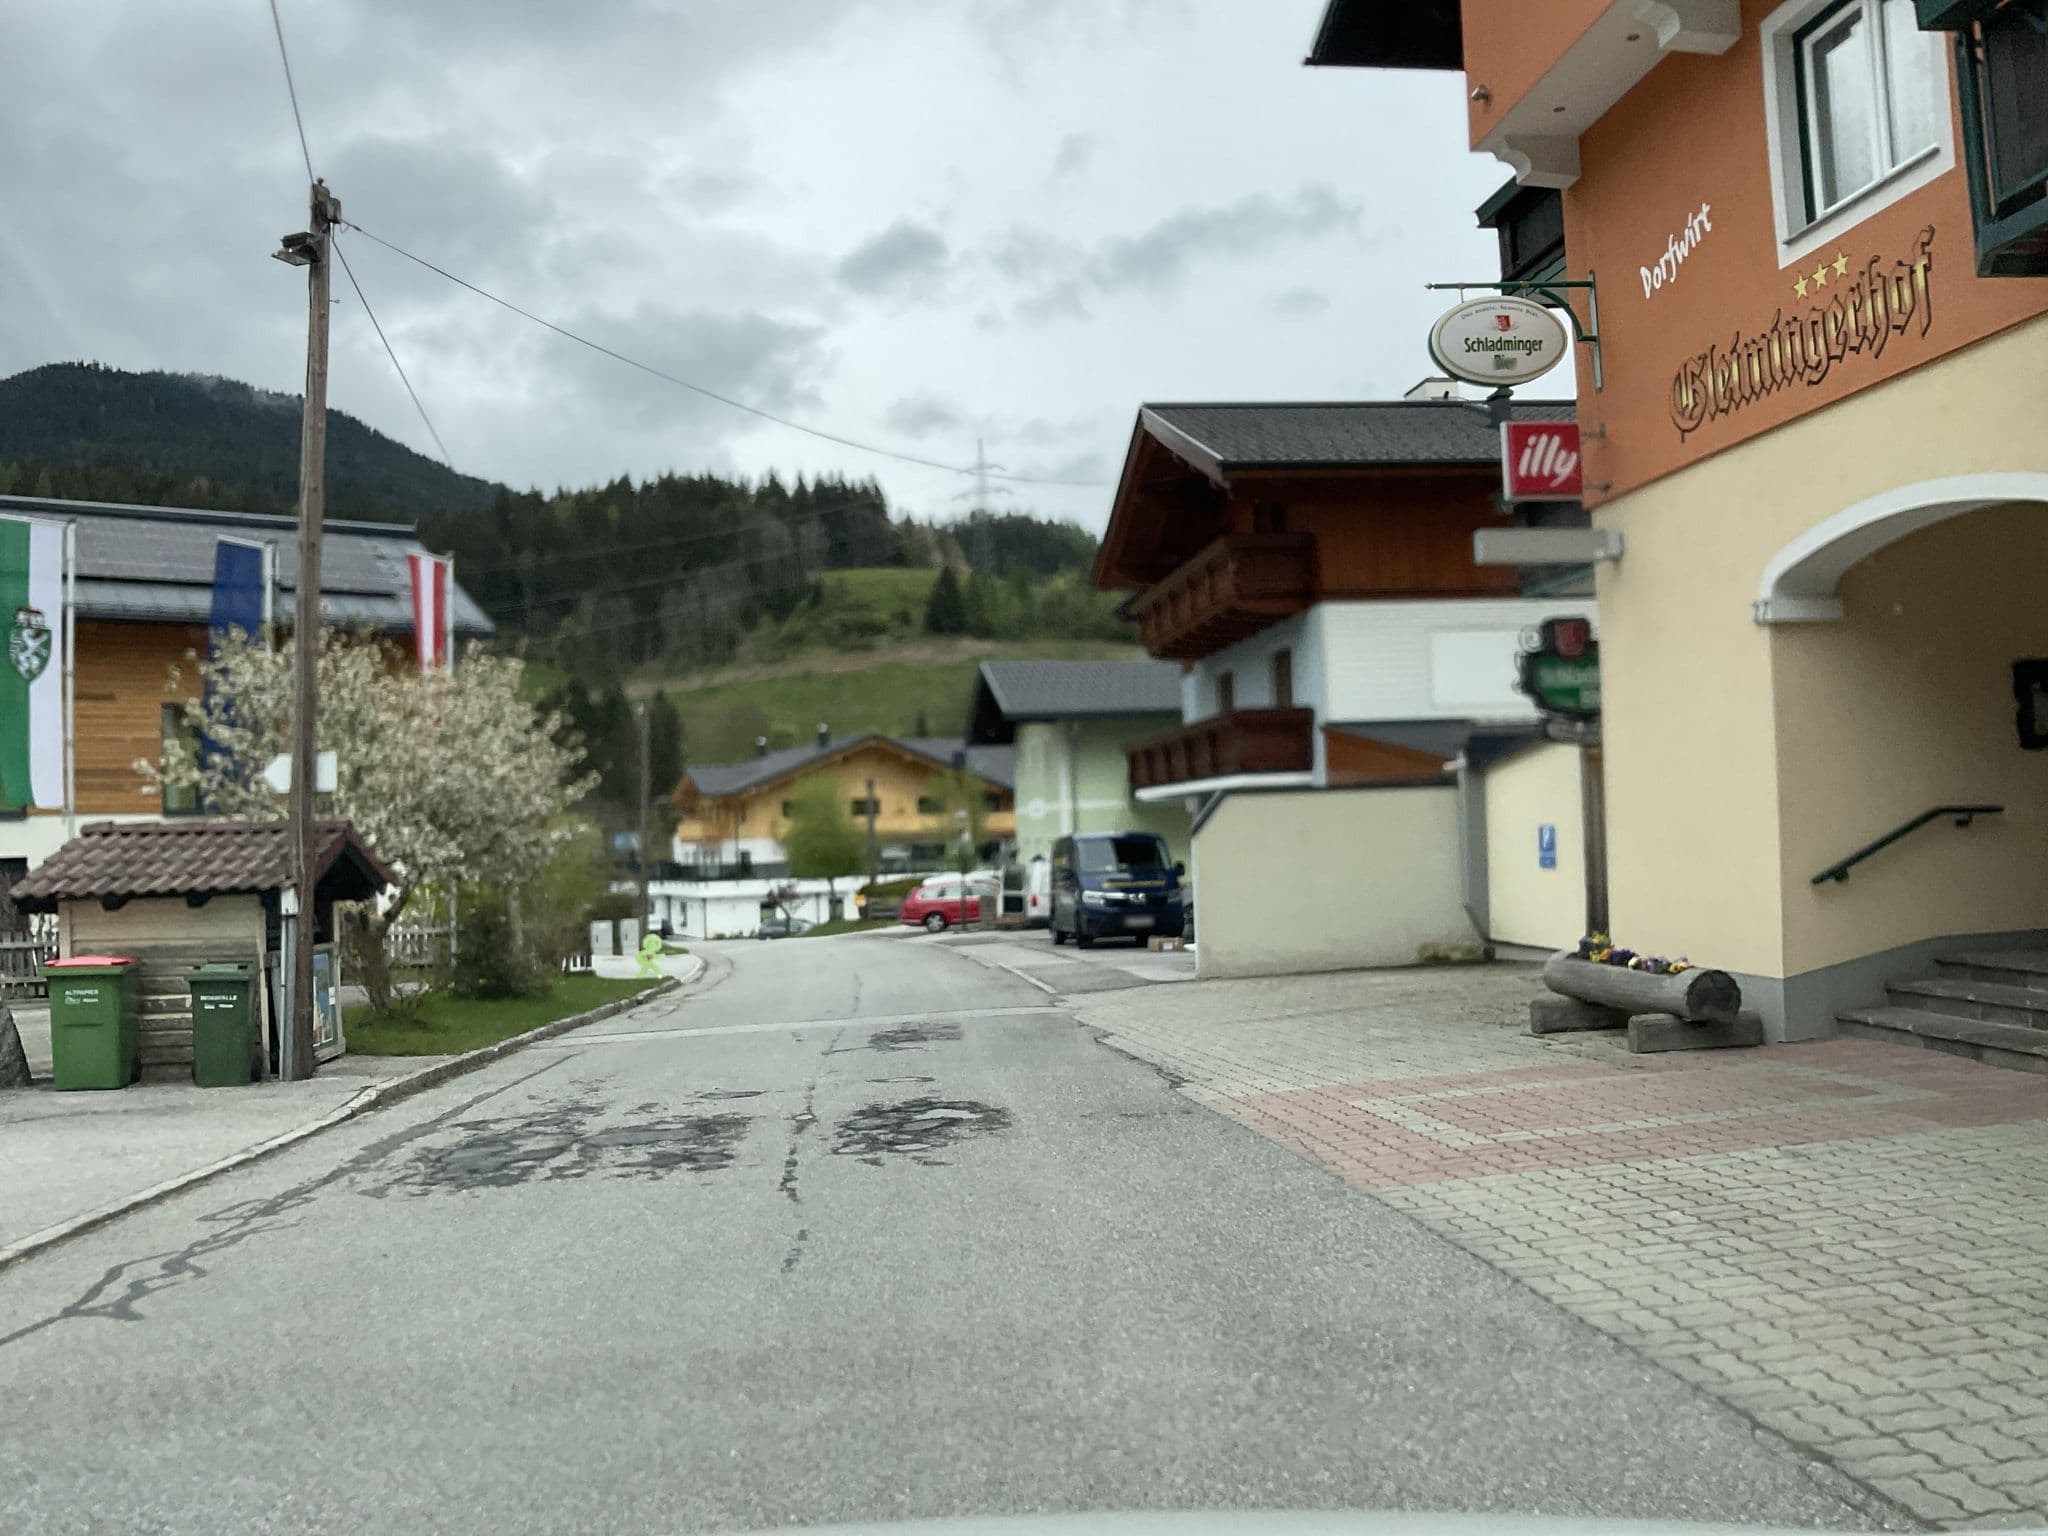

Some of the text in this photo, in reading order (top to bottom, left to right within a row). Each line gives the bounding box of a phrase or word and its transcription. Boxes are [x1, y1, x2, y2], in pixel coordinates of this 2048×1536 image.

[1640, 202, 1713, 299] Dorfwirt
[1464, 335, 1543, 356] Schladminger
[1519, 433, 1577, 488] illy
